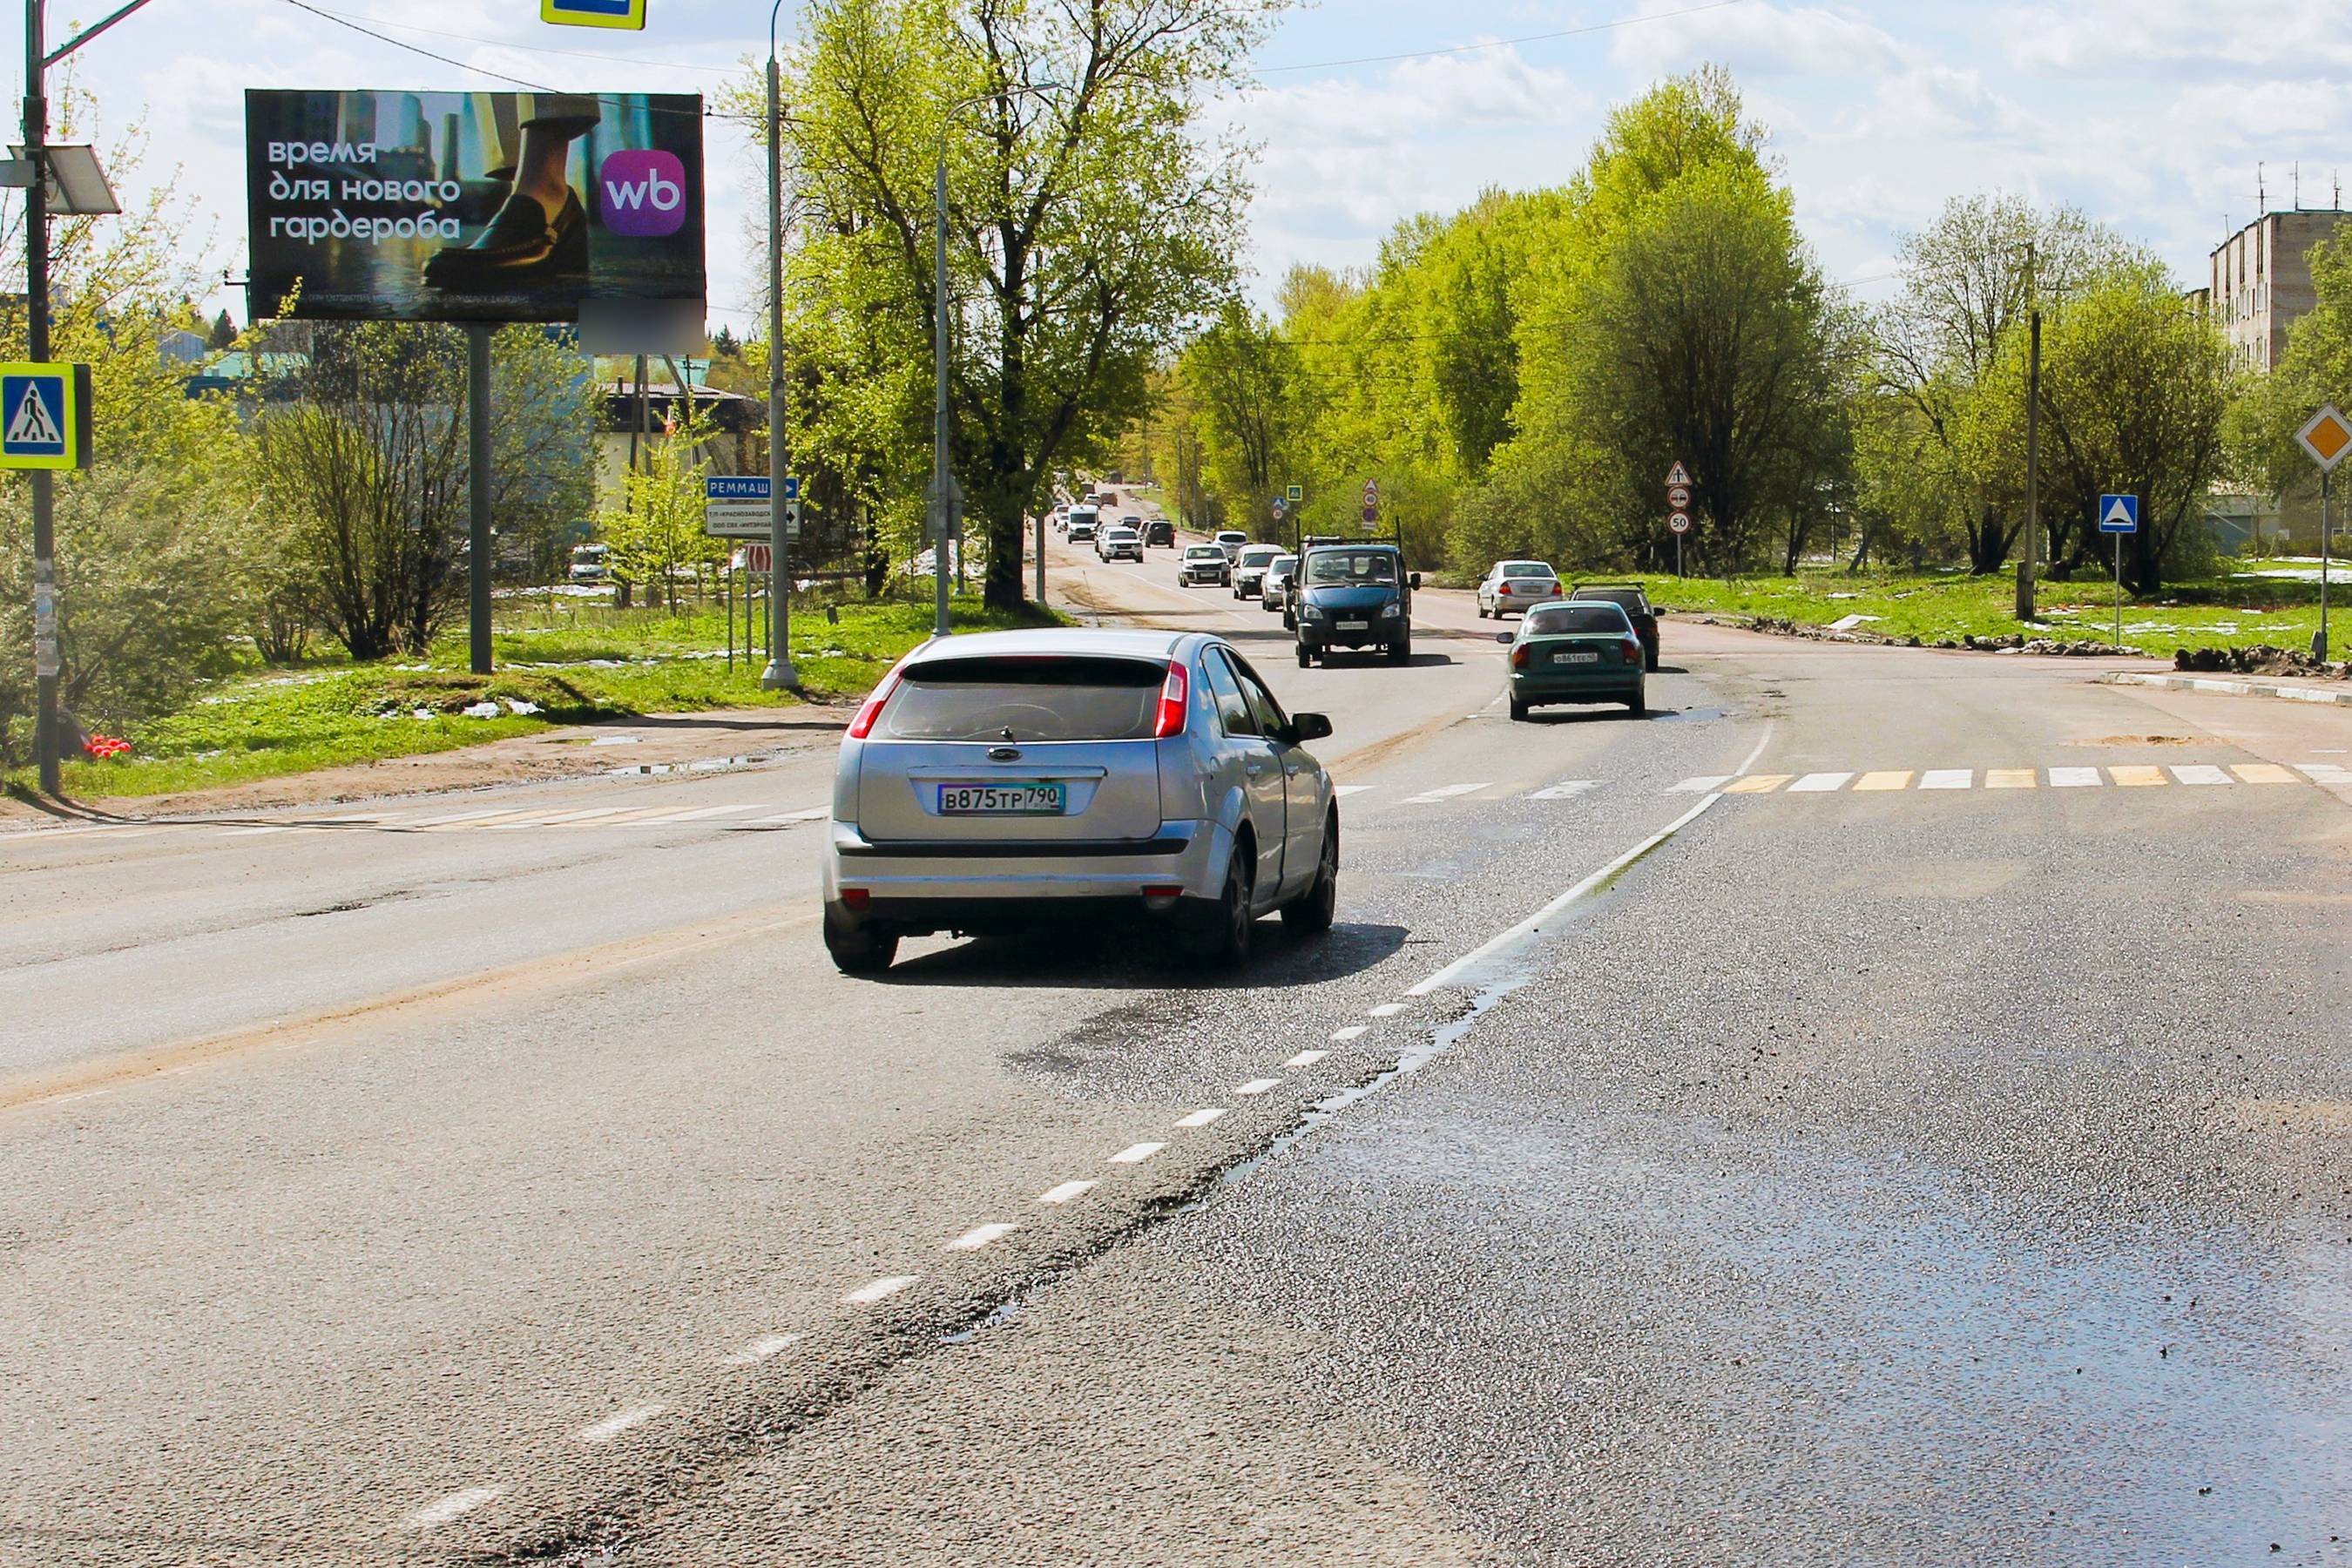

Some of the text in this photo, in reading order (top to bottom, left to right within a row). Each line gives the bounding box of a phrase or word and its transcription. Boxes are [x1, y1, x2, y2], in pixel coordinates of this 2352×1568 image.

[268, 141, 376, 170] время
[269, 171, 461, 201] для нового
[605, 168, 679, 211] wb
[270, 208, 461, 246] гардероба
[710, 483, 768, 493] РЕММАШ
[1673, 518, 1686, 527] 50
[945, 787, 1057, 808] В875ТР 790
